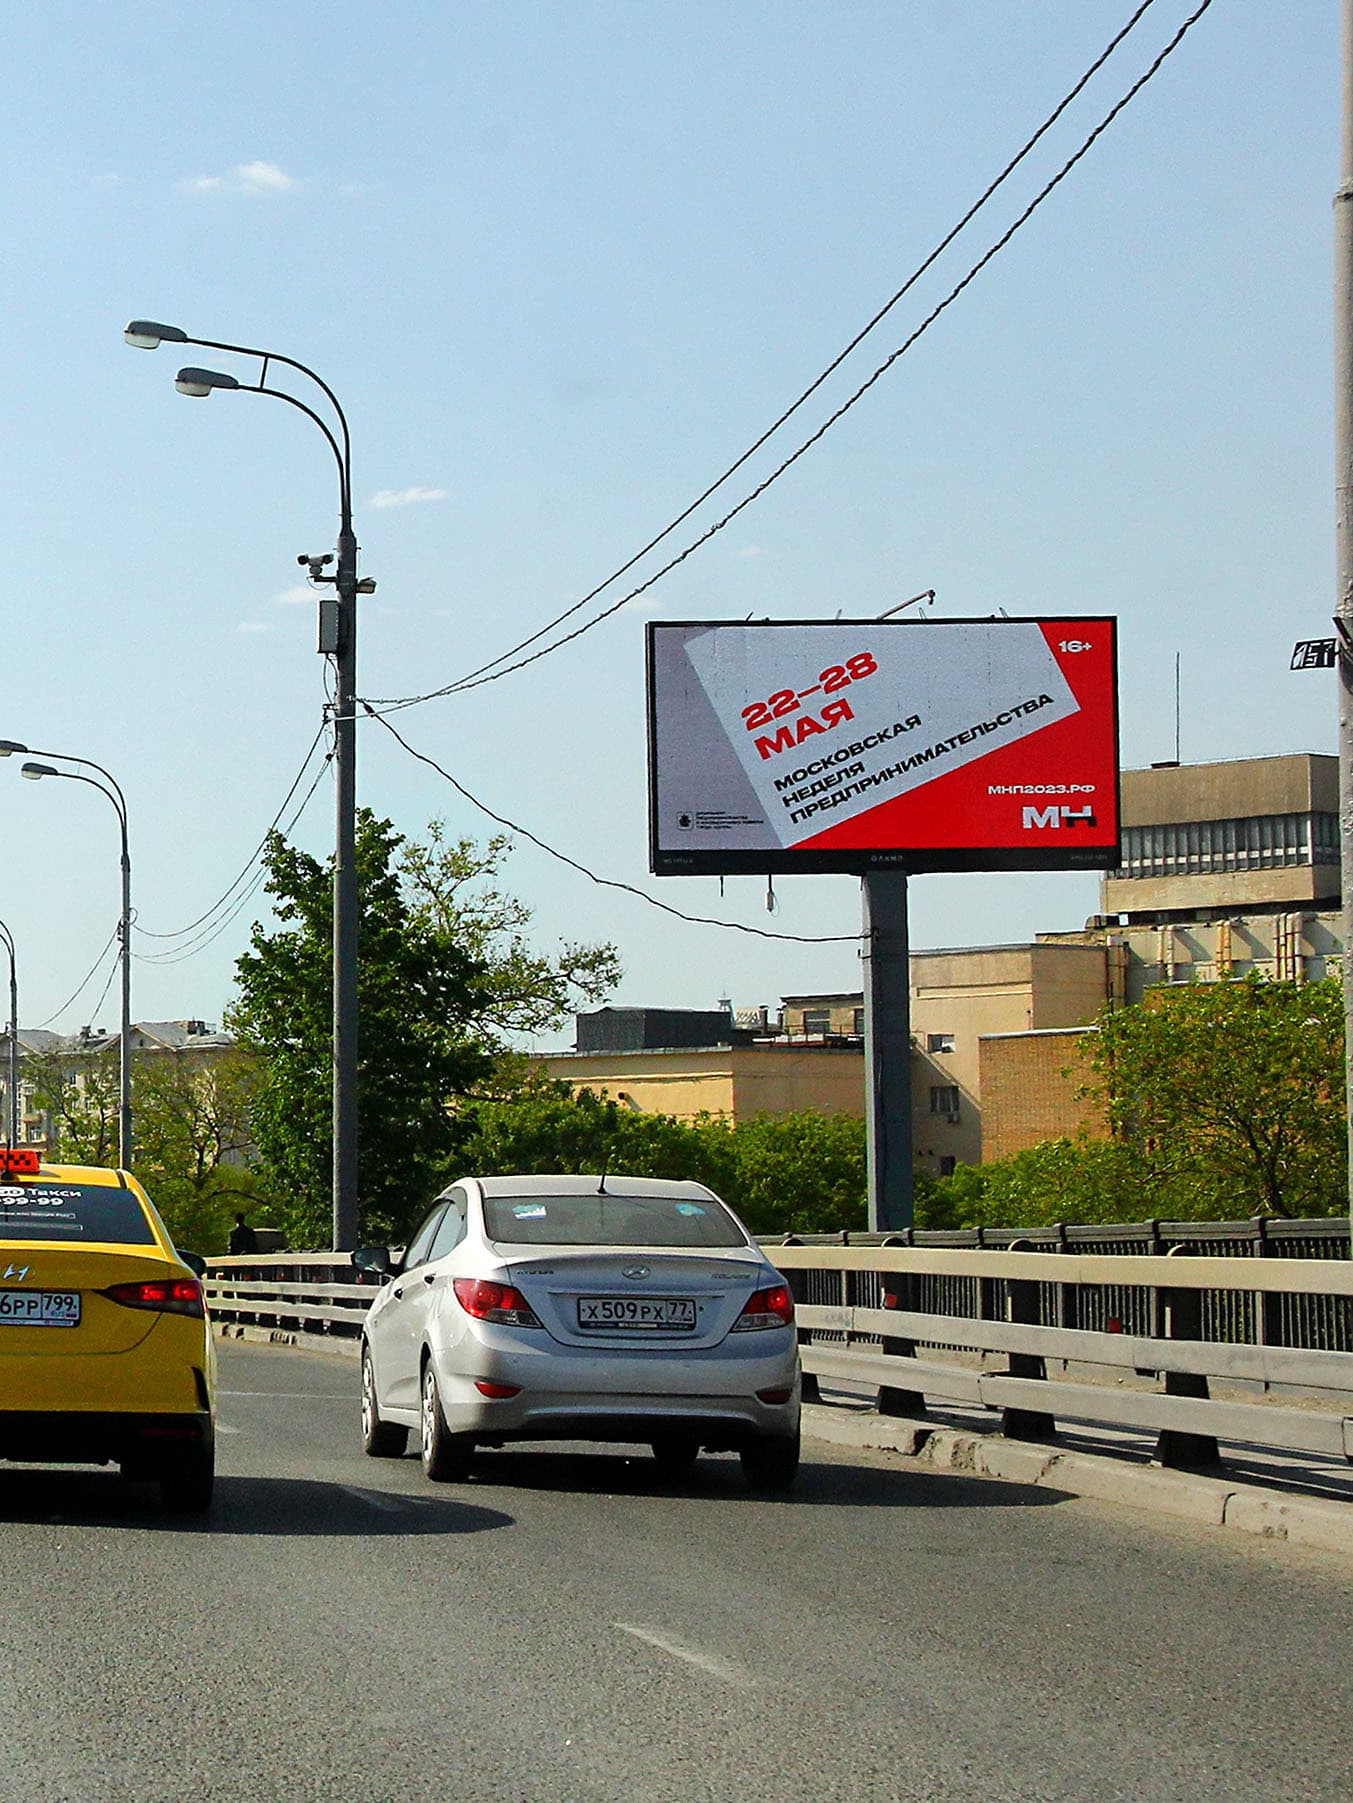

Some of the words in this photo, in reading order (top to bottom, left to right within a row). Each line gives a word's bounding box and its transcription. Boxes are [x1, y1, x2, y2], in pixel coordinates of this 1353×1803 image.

[1058, 639, 1093, 654] 16+
[752, 698, 875, 760] МАЯ
[773, 714, 922, 792] МОСКОВСКАЯ
[789, 693, 1054, 824] ПРЕДПРИНИМАТЕЛЬСТВА
[782, 761, 865, 808] НЕДЕЛЯ
[988, 784, 1096, 795] МНП2023.РФ
[27, 1187, 82, 1197] Такси
[43, 1294, 74, 1312] 799
[668, 1302, 687, 1316] 77
